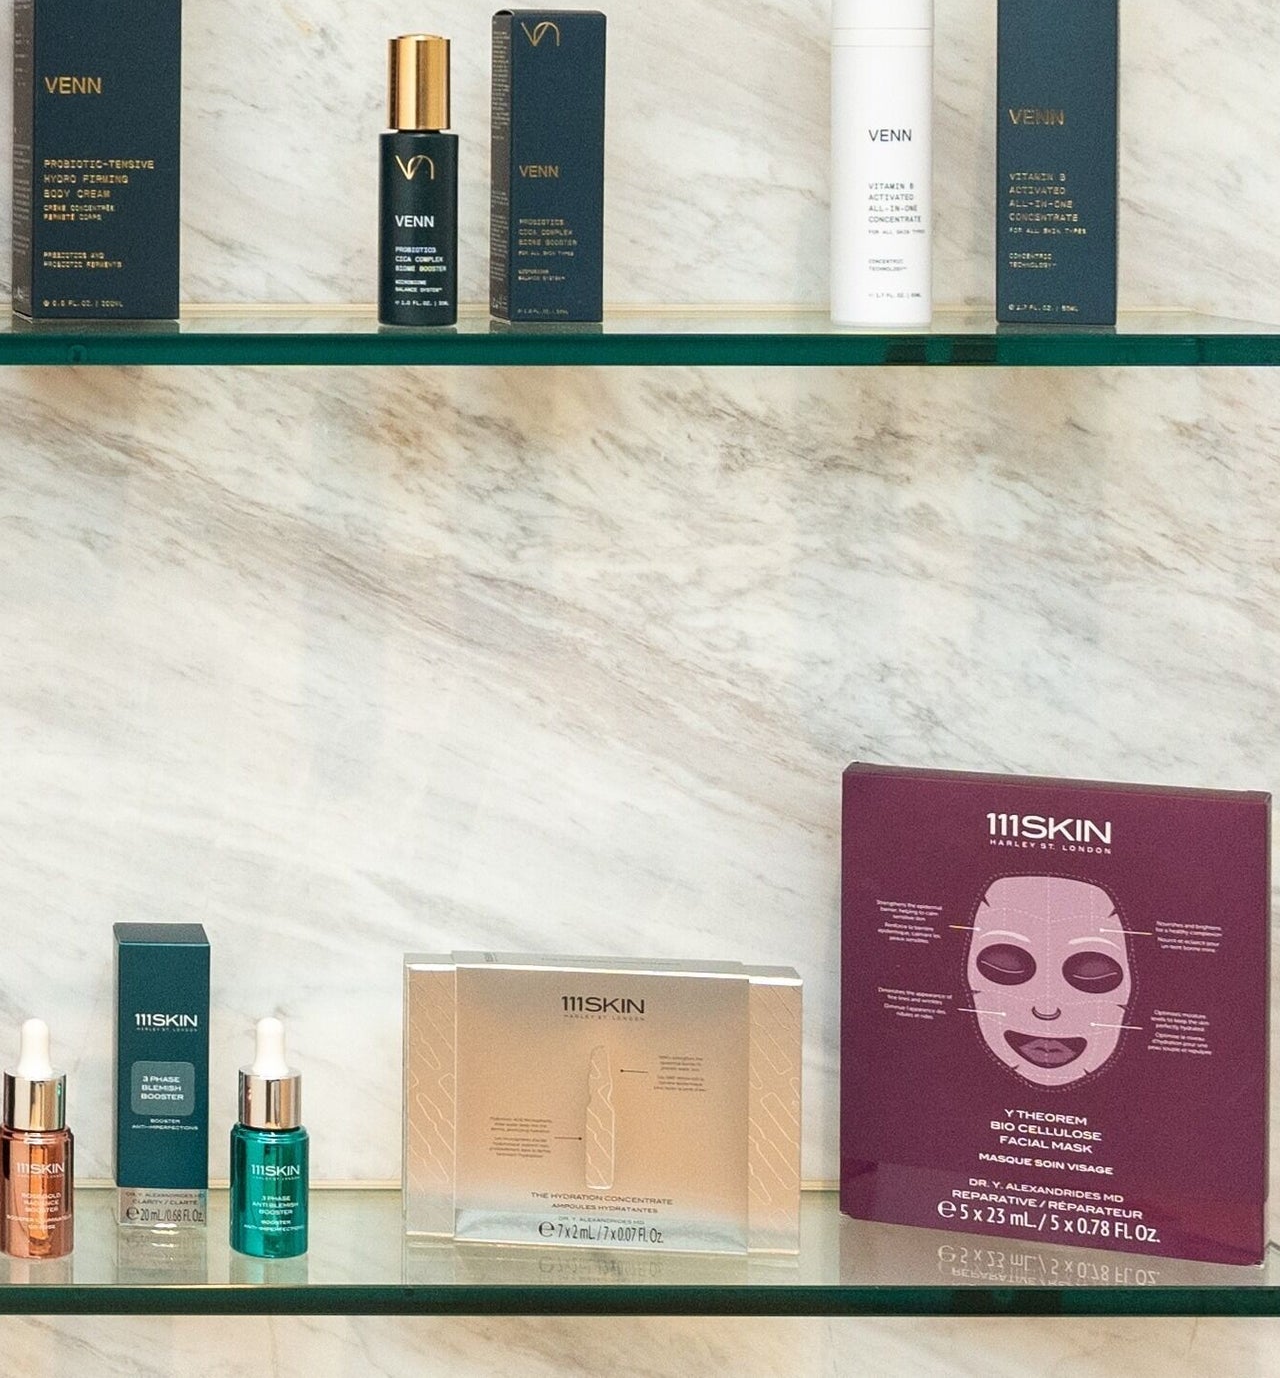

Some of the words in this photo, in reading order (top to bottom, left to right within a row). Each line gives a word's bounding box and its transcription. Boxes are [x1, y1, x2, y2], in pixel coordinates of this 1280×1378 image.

[44, 77, 102, 95] VENN
[868, 129, 912, 142] VENN
[43, 159, 155, 169] PROBIOTIC-TENSIVE
[519, 165, 559, 178] VENN
[43, 174, 77, 183] HYDRO
[83, 174, 129, 184] FIRMING
[868, 182, 905, 190] VITAMIN
[1009, 186, 1066, 195] ACTIVATED
[43, 189, 71, 198] BODY
[77, 189, 111, 198] CREAM
[868, 193, 914, 201] ACTIVATED
[868, 204, 918, 212] ALL-IN-ONE
[395, 215, 434, 228] VENN
[868, 215, 921, 223] CONCENTRATE
[1009, 212, 1079, 222] CONCENTRATE
[986, 812, 1112, 845] 111SKIN
[989, 838, 1036, 849] HARLEY
[1040, 842, 1055, 851] ST.
[1061, 844, 1112, 855] LONDON
[561, 995, 645, 1014] 111SKIN
[135, 1013, 198, 1027] 111SKIN
[140, 1093, 184, 1101] BOOSTER
[1003, 1109, 1015, 1118] Y
[1016, 1110, 1088, 1127] THEOREM
[990, 1120, 1015, 1132] BIO
[1017, 1123, 1103, 1141] CELLULOSE
[999, 1135, 1049, 1149] FACIAL
[1051, 1142, 1093, 1154] MASK
[251, 1164, 300, 1177] 111SKIN
[978, 1152, 1032, 1167] MASQUE
[1033, 1159, 1066, 1170] SOIN
[1067, 1163, 1114, 1176] VISAGE
[968, 1178, 990, 1188] DR.
[1004, 1182, 1101, 1201] ALEXANDRIDES
[1103, 1194, 1125, 1203] MD
[951, 1189, 1037, 1207] REPARATIVE
[1047, 1200, 1143, 1220] RÉPARATEUR
[960, 1205, 968, 1220] 5
[986, 1206, 1005, 1224] 23
[1050, 1215, 1059, 1232] 5
[1077, 1217, 1110, 1237] 0.78
